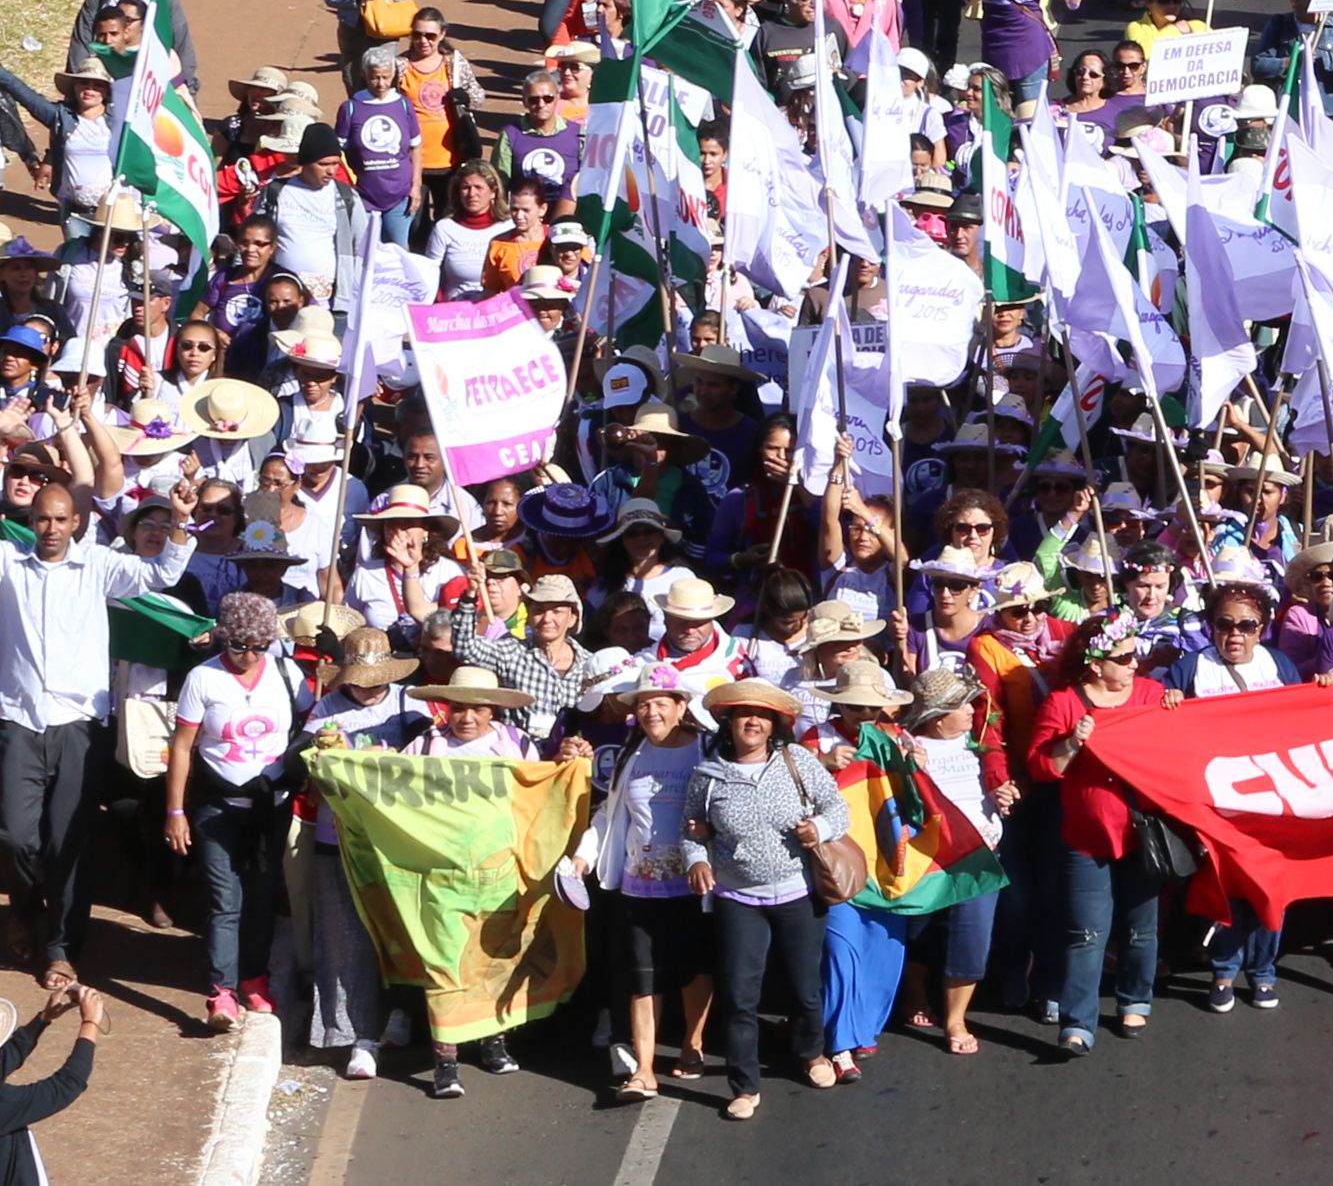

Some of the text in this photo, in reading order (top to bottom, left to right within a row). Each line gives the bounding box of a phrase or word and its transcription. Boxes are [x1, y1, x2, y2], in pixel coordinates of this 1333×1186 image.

[1163, 39, 1232, 57] EM DEFESA
[1187, 59, 1204, 73] DA
[1149, 67, 1239, 93] DEMOCRACIA
